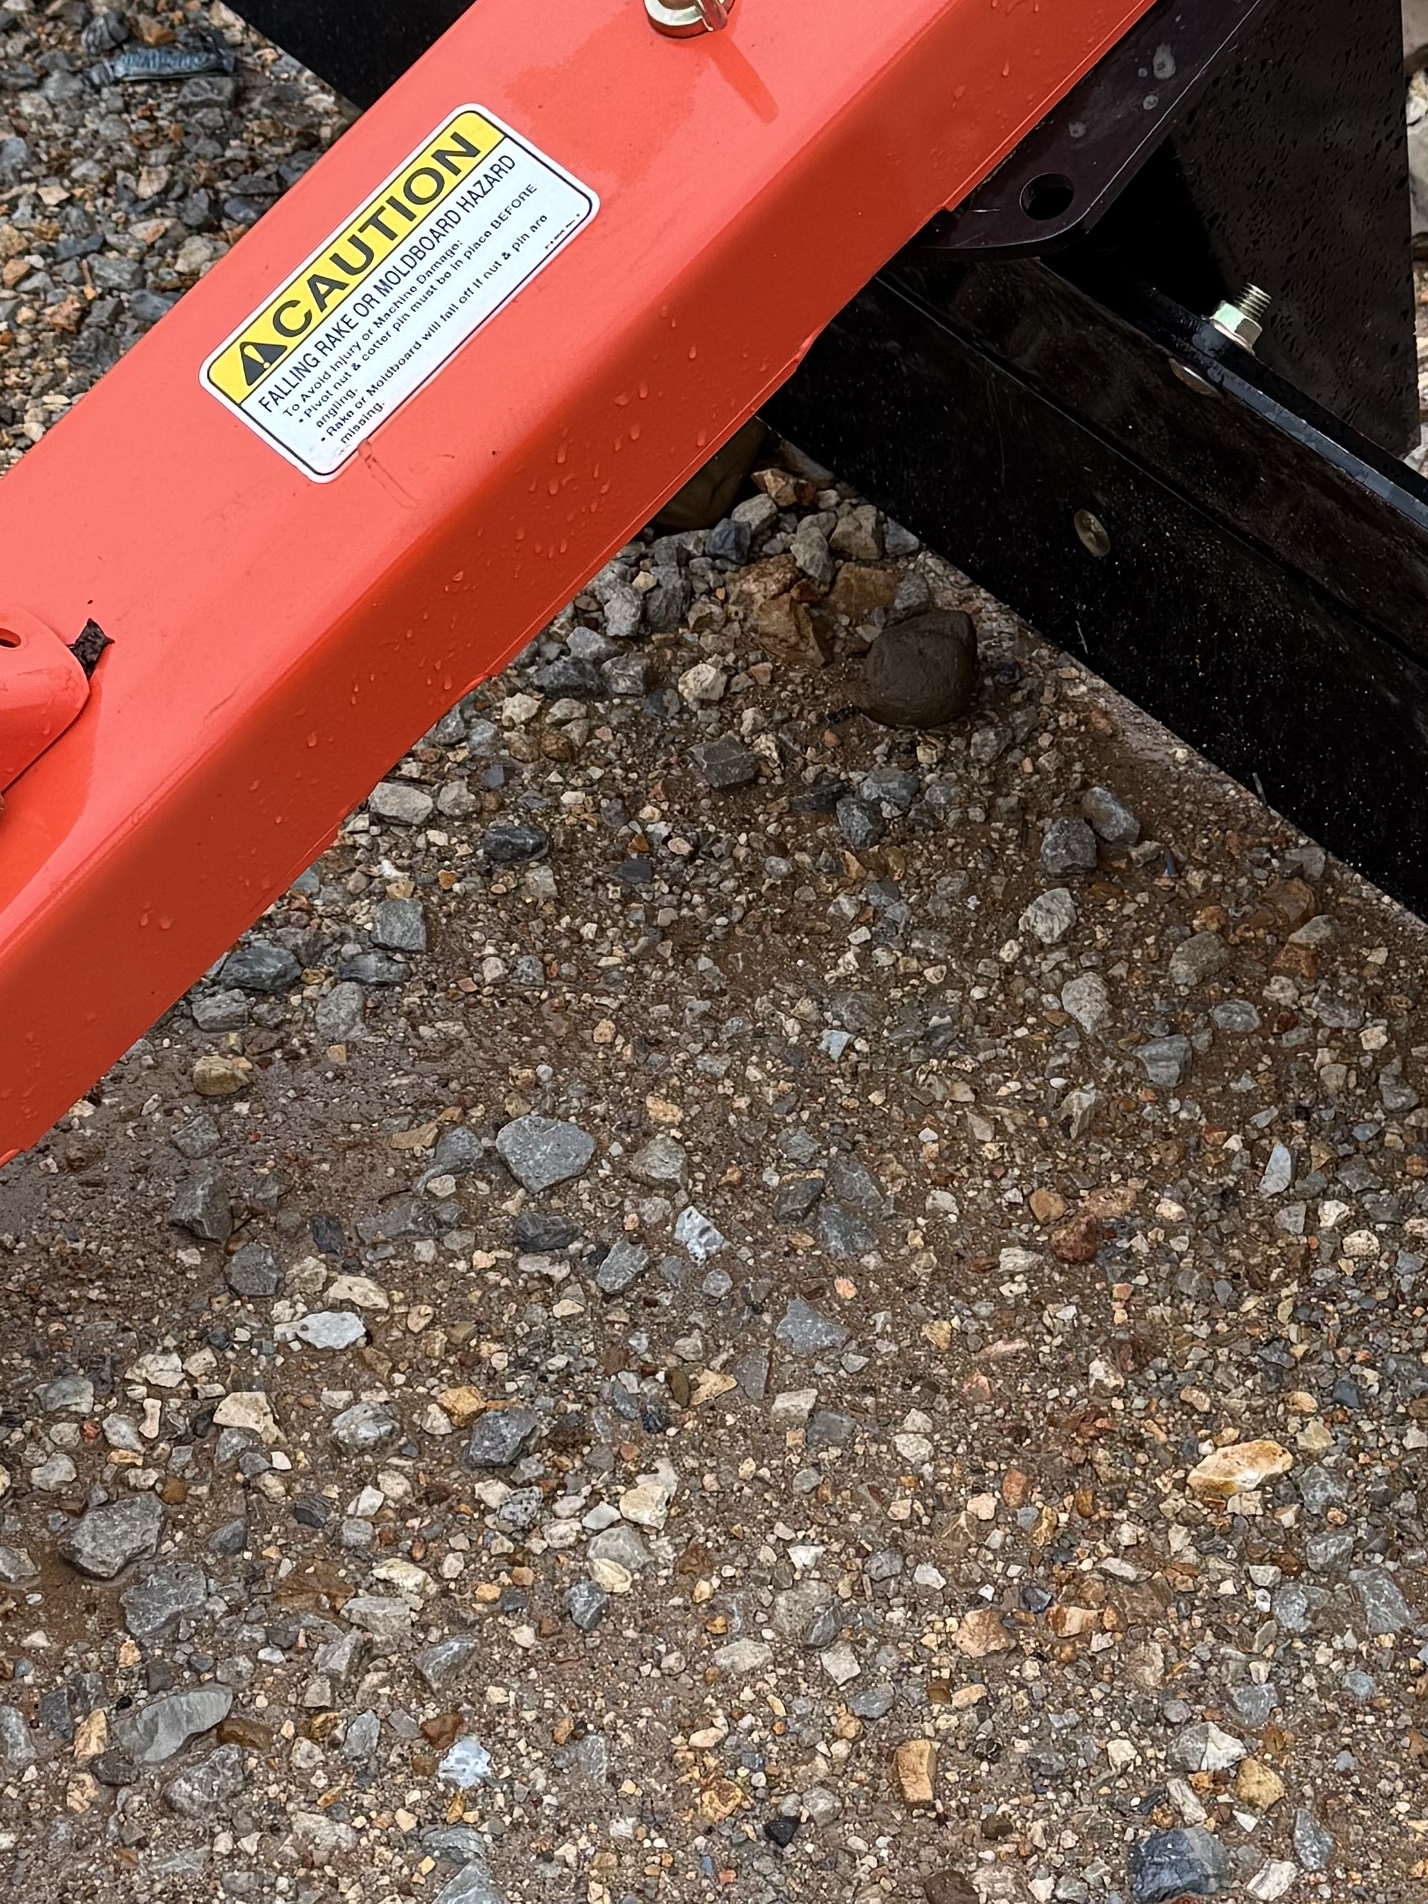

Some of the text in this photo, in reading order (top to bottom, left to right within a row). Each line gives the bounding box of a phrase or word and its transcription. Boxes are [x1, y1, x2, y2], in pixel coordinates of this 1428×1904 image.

[257, 152, 518, 414] FALLING RAKE OR MOLDBOARD HAZARD
[265, 130, 483, 344] CAUTION
[282, 237, 464, 419] To Avoid Injury or Machine Damage:
[302, 182, 538, 419] Pivot nut & cotter pin must be in place BEFORE
[325, 213, 548, 437] Rake or Moldboard will fall off if nut & pin are
[313, 383, 360, 430] angling.
[338, 397, 387, 446] missing.
